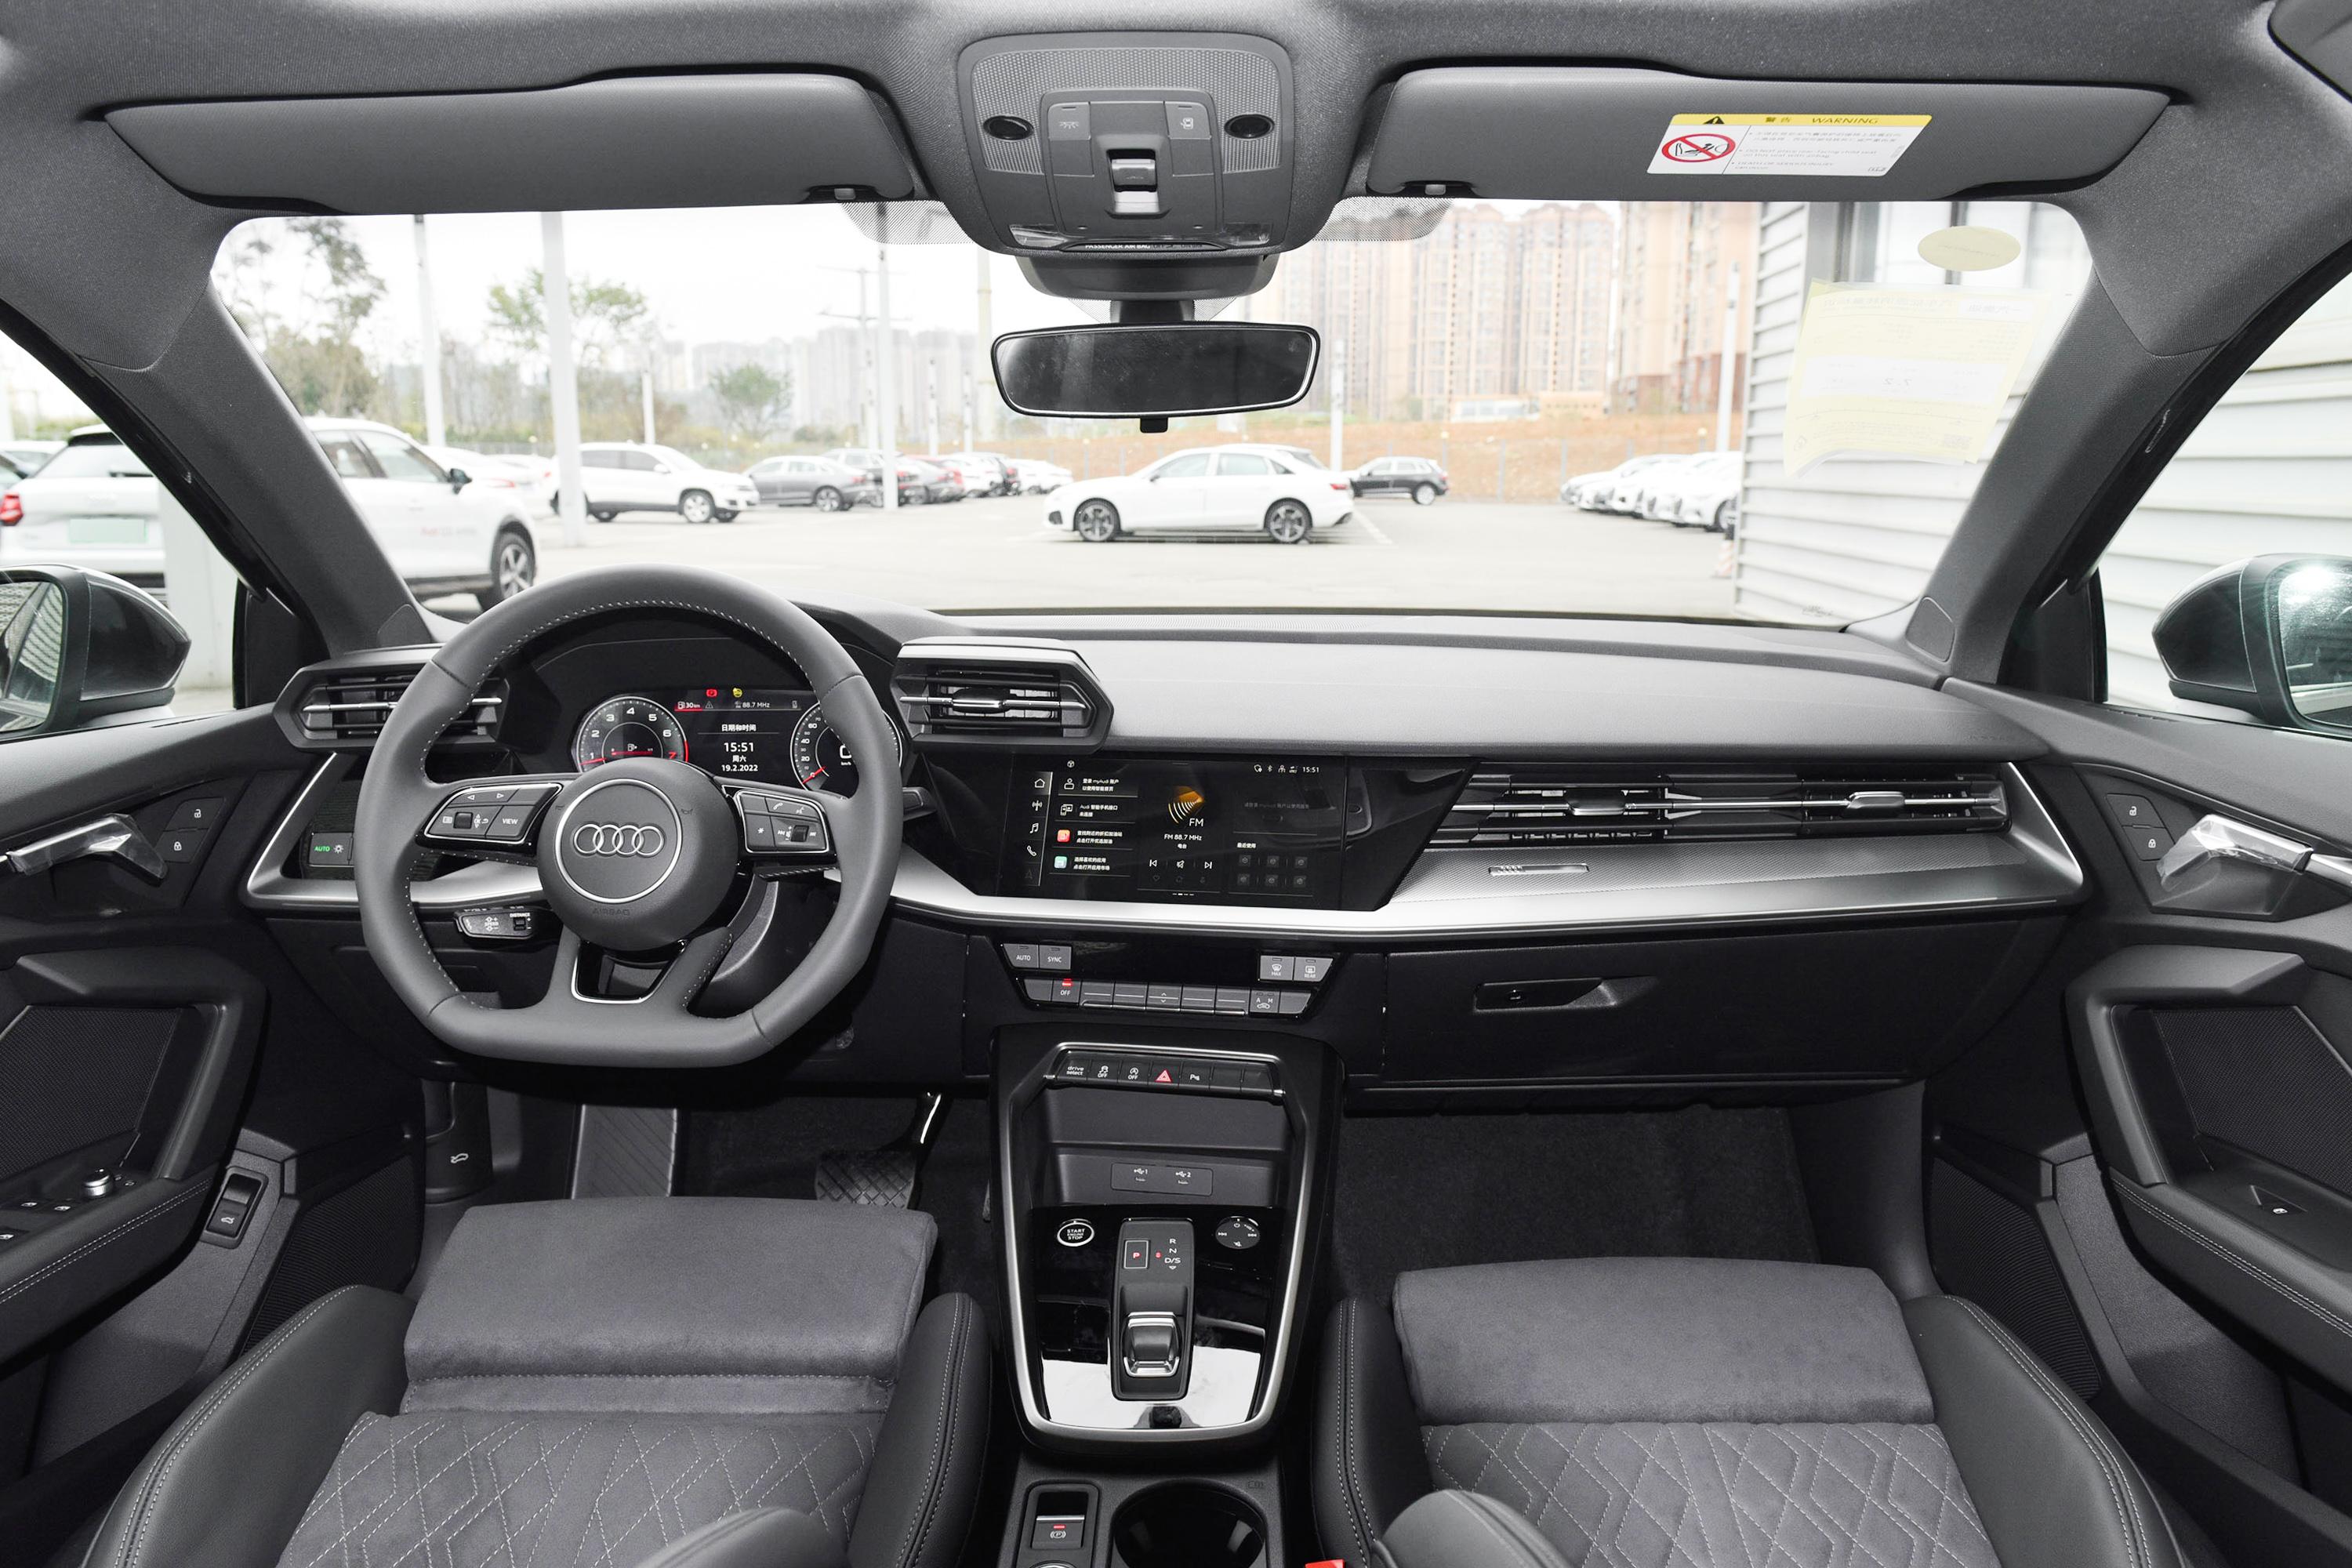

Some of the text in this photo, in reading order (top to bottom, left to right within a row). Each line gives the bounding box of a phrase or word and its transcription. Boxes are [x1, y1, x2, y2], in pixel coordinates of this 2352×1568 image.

[721, 724, 757, 732] 日期和时间
[724, 742, 755, 753] 15:51
[1189, 818, 1204, 827] FM
[593, 907, 630, 916] AIRBAG
